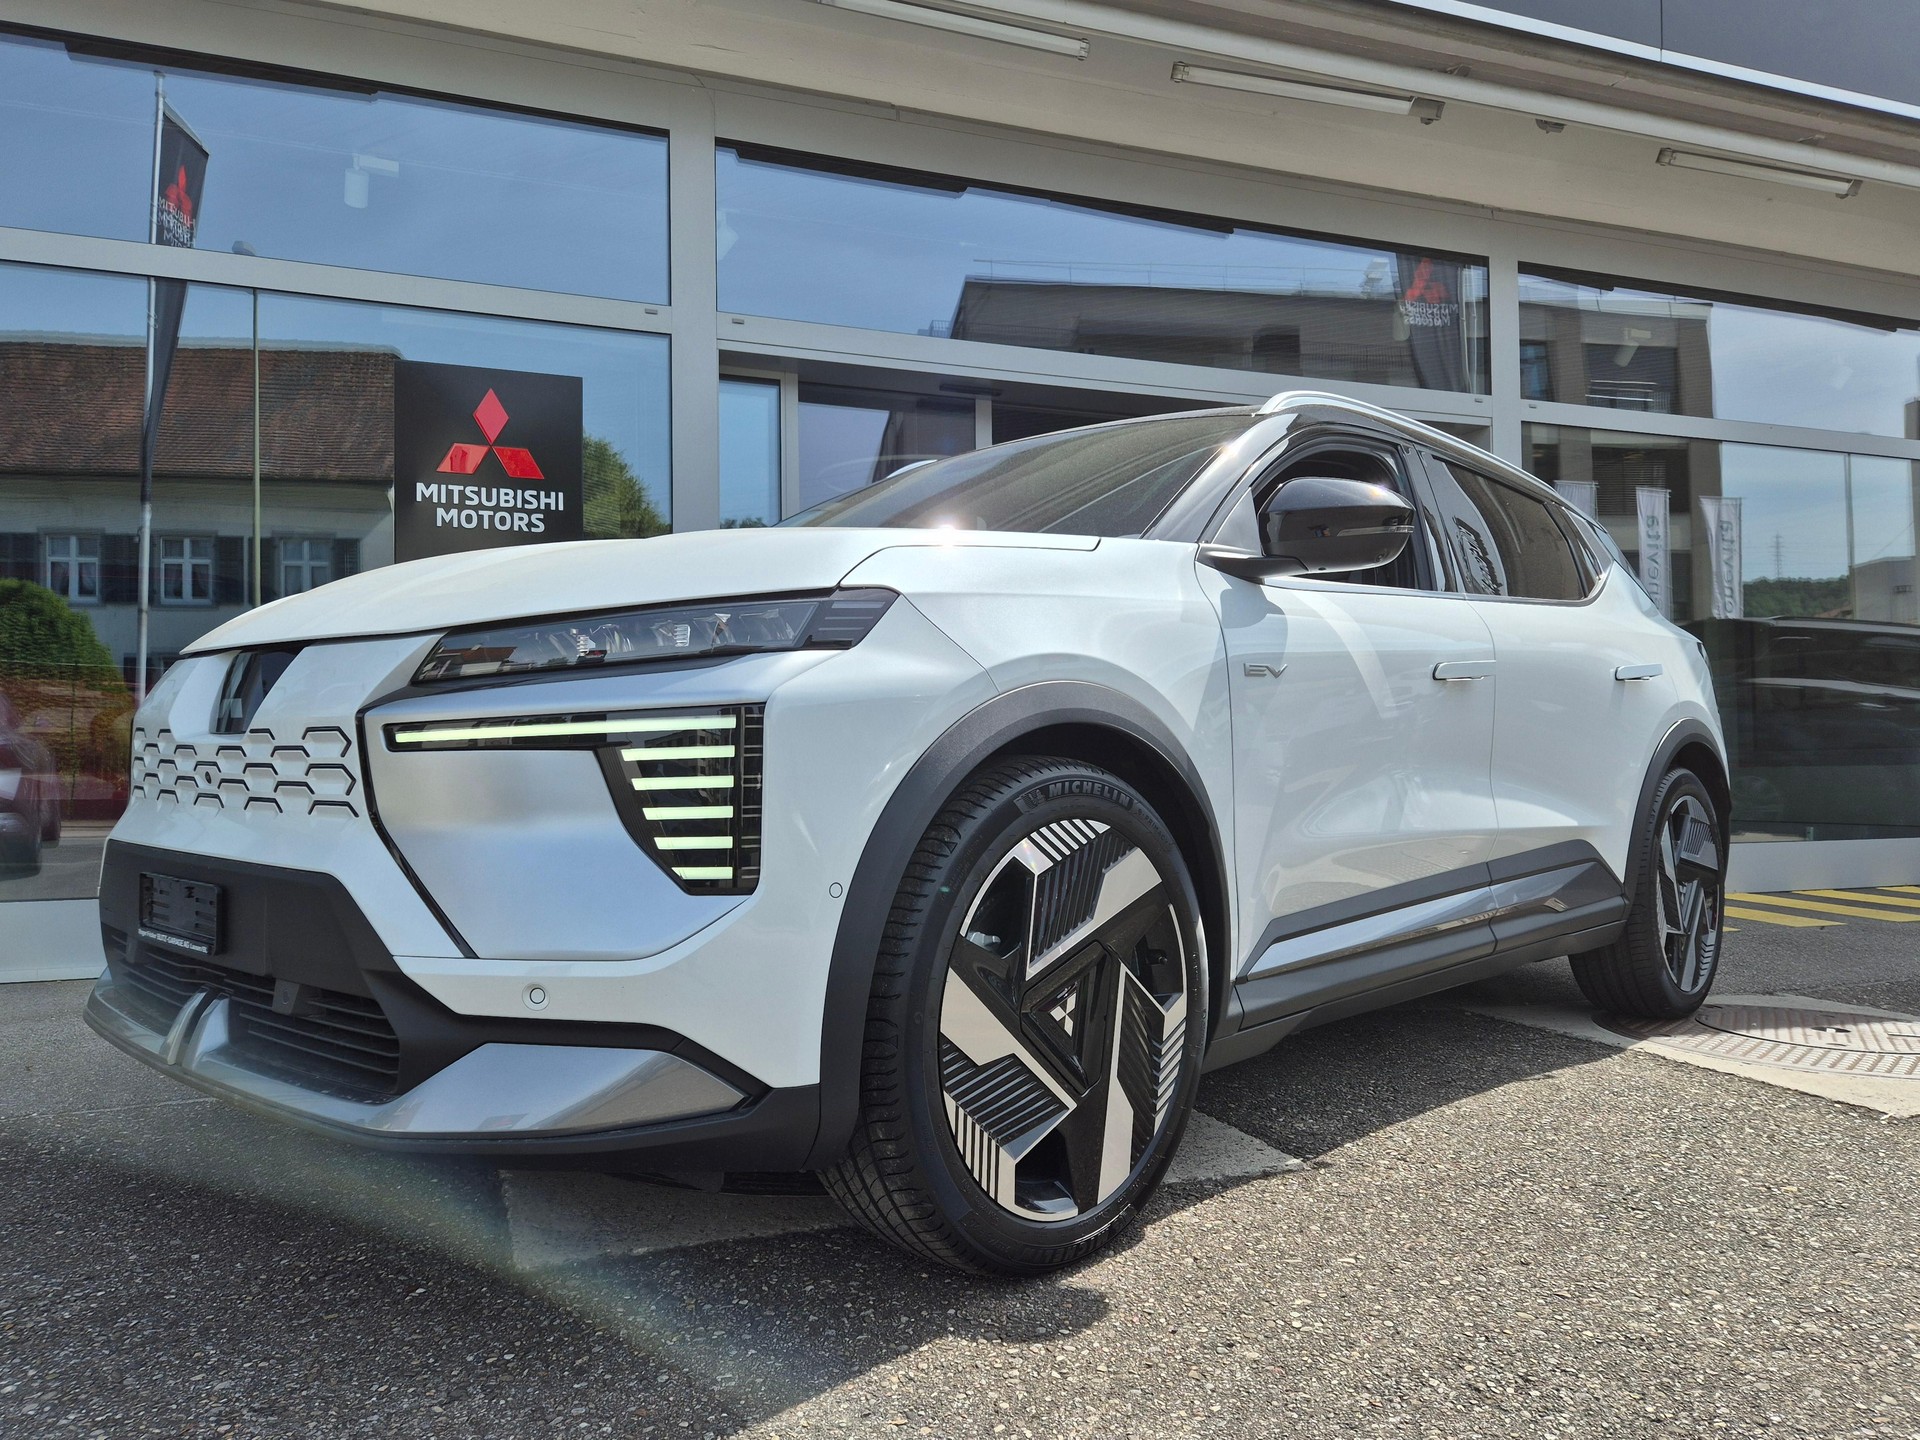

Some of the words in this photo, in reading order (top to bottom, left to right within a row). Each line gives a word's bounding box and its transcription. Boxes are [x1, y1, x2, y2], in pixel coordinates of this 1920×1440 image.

[416, 482, 564, 511] MITSUBISHI
[436, 507, 545, 533] MOTORS
[1243, 663, 1288, 679] EV
[1049, 780, 1131, 811] MICHELIN
